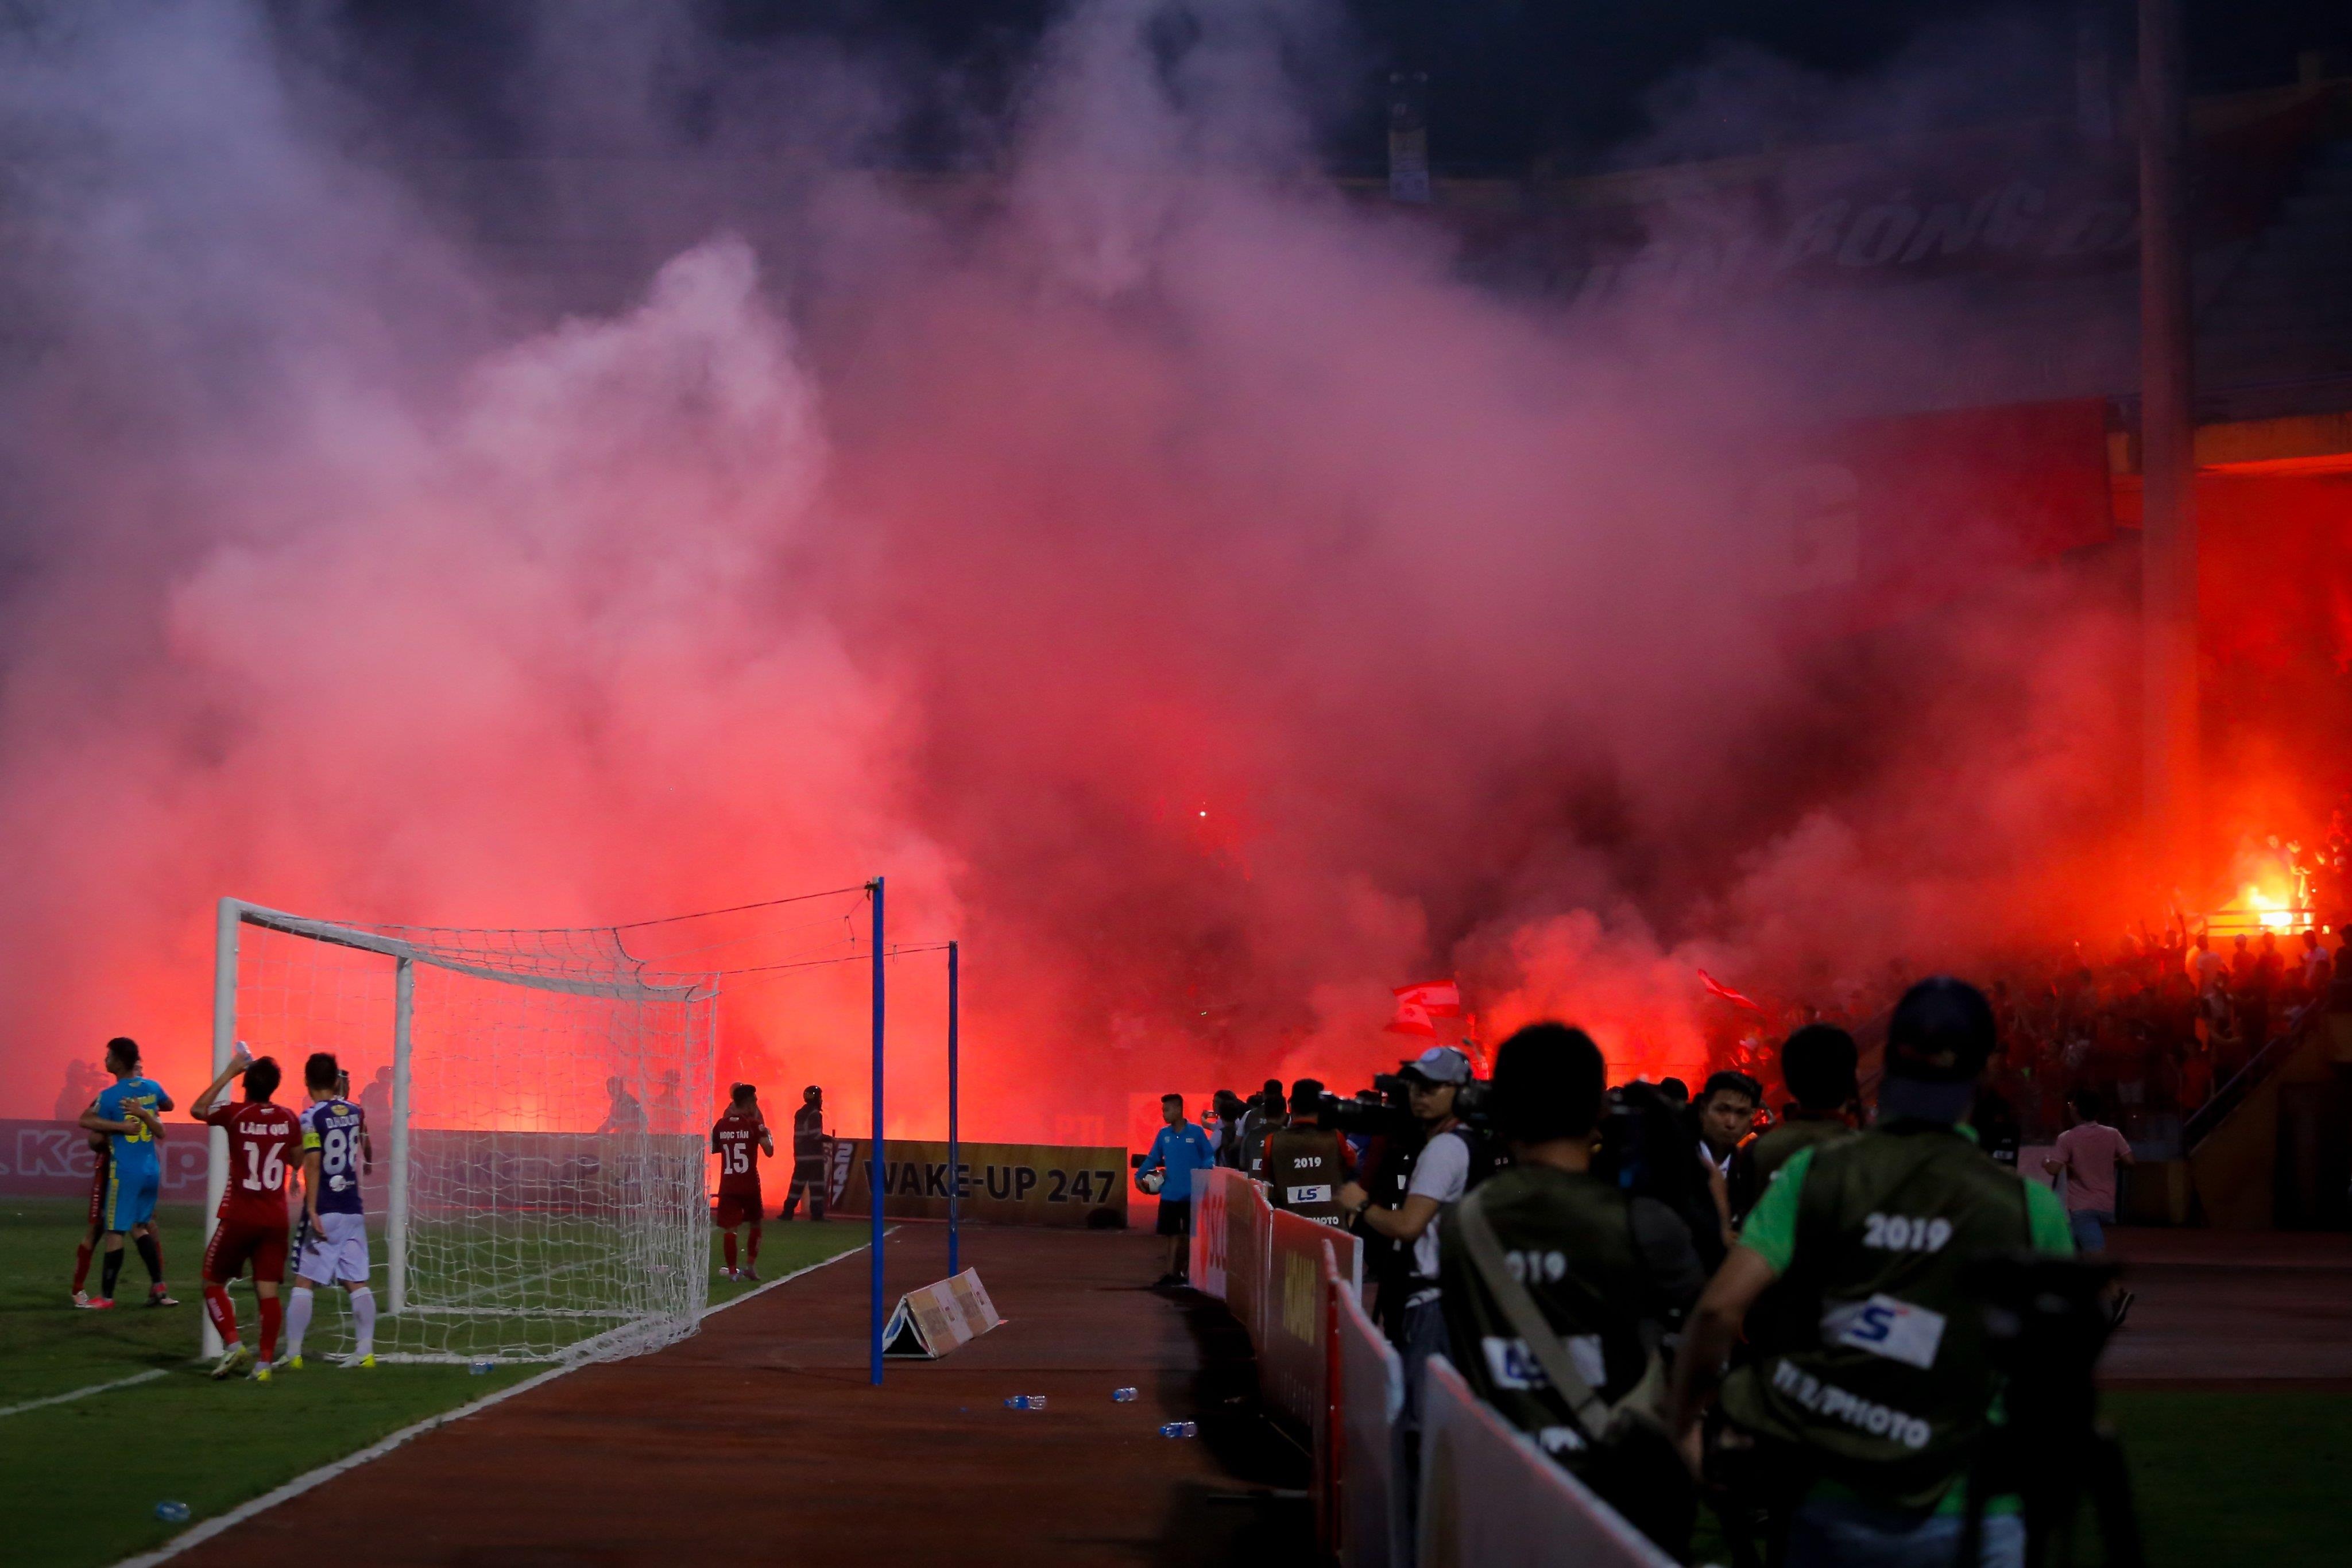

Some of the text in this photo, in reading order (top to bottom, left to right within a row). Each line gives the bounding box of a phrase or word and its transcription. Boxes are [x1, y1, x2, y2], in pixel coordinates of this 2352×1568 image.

[242, 1141, 287, 1191] 16
[722, 1143, 749, 1175] 15
[1294, 1156, 1322, 1169] 2019
[864, 1160, 1115, 1203] WAKE-UP 247
[1297, 1188, 1318, 1201] LS
[1859, 1211, 1953, 1249] 2019
